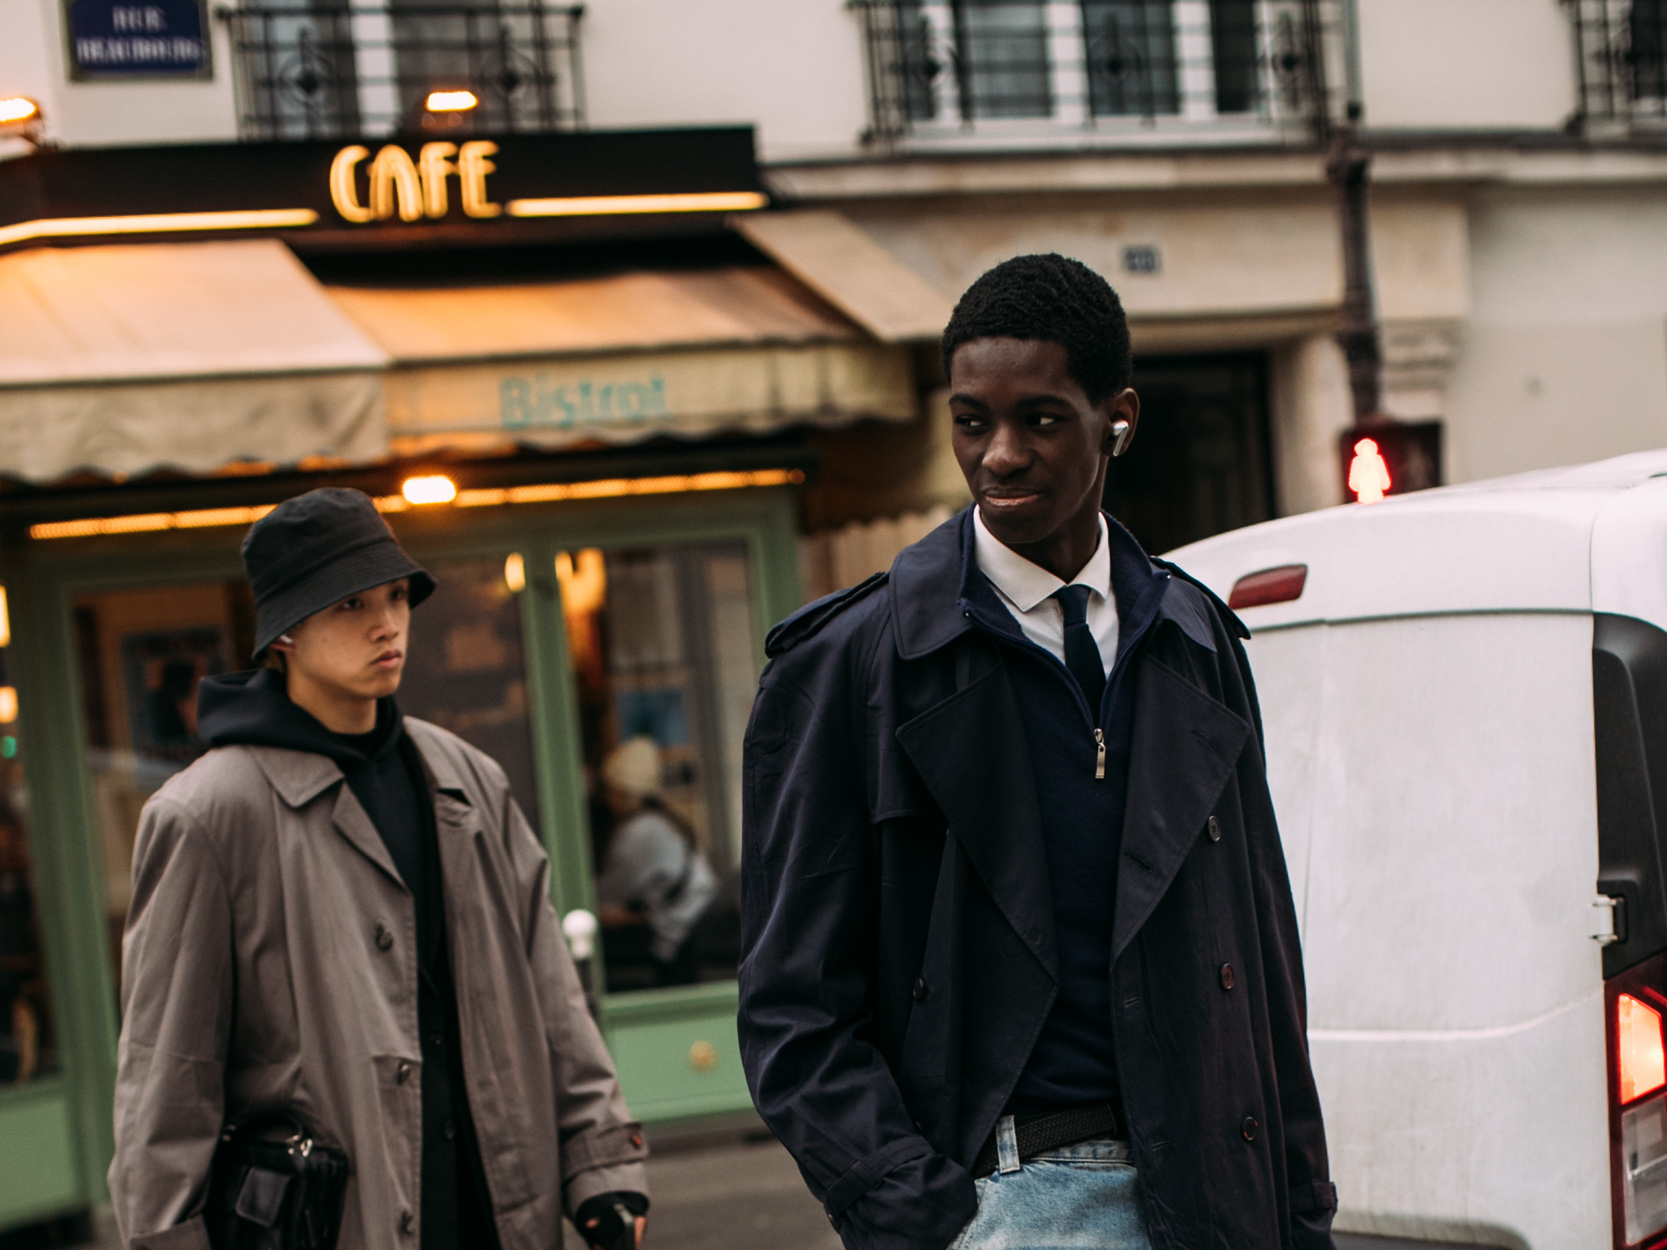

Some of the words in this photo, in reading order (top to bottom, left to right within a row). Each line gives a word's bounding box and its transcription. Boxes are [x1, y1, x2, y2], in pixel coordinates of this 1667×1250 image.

[112, 5, 166, 31] RUE
[329, 140, 502, 223] CAFE
[500, 373, 668, 430] Bistrot
